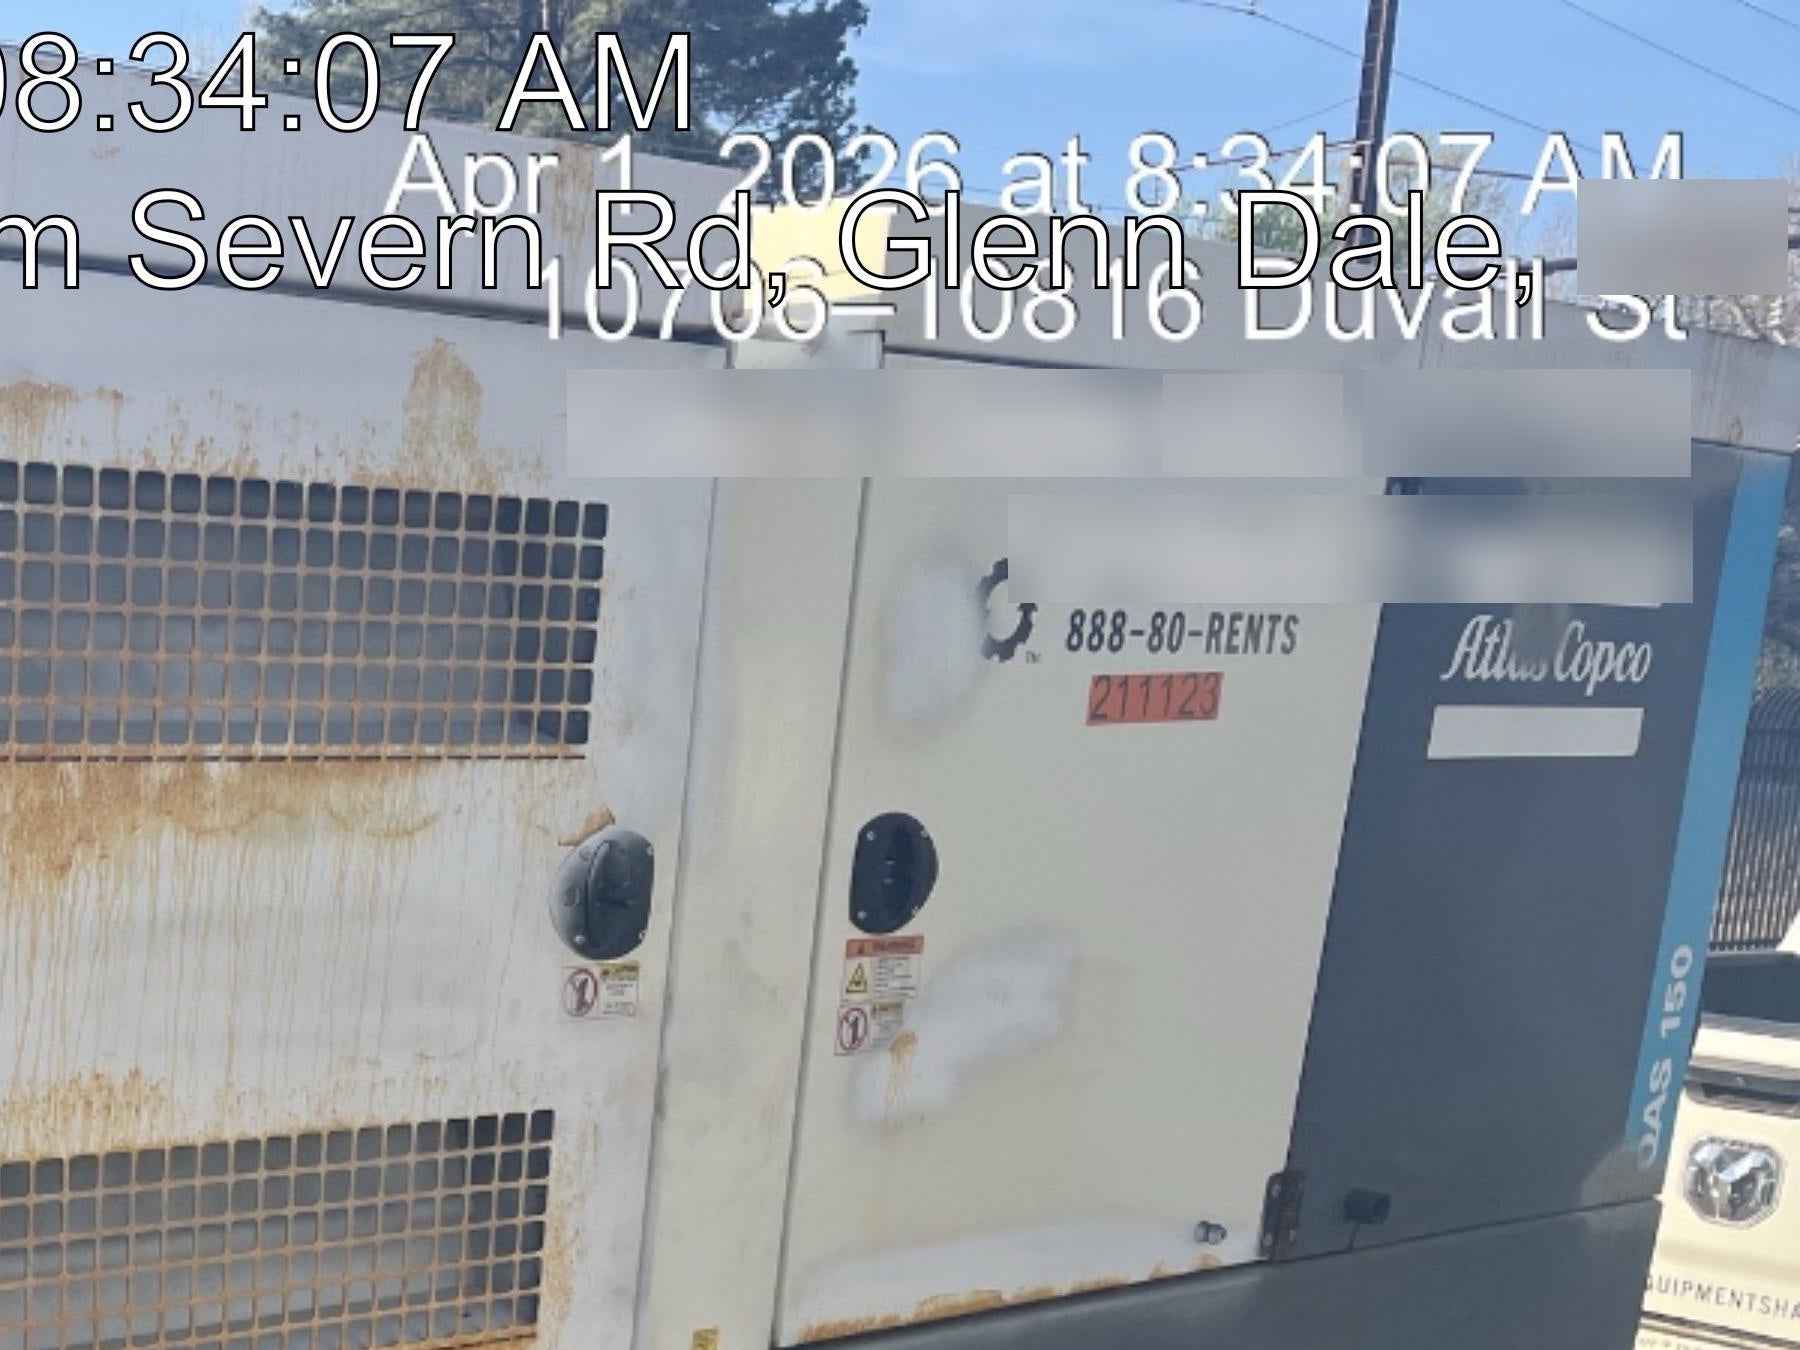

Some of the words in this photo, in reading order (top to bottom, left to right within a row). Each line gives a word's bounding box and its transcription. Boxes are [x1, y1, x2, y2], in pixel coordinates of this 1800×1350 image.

[1065, 608, 1301, 656] 888-80-RENTS
[1553, 619, 1653, 698] Copco
[1089, 671, 1222, 721] 211123
[1660, 943, 1694, 1039] 150
